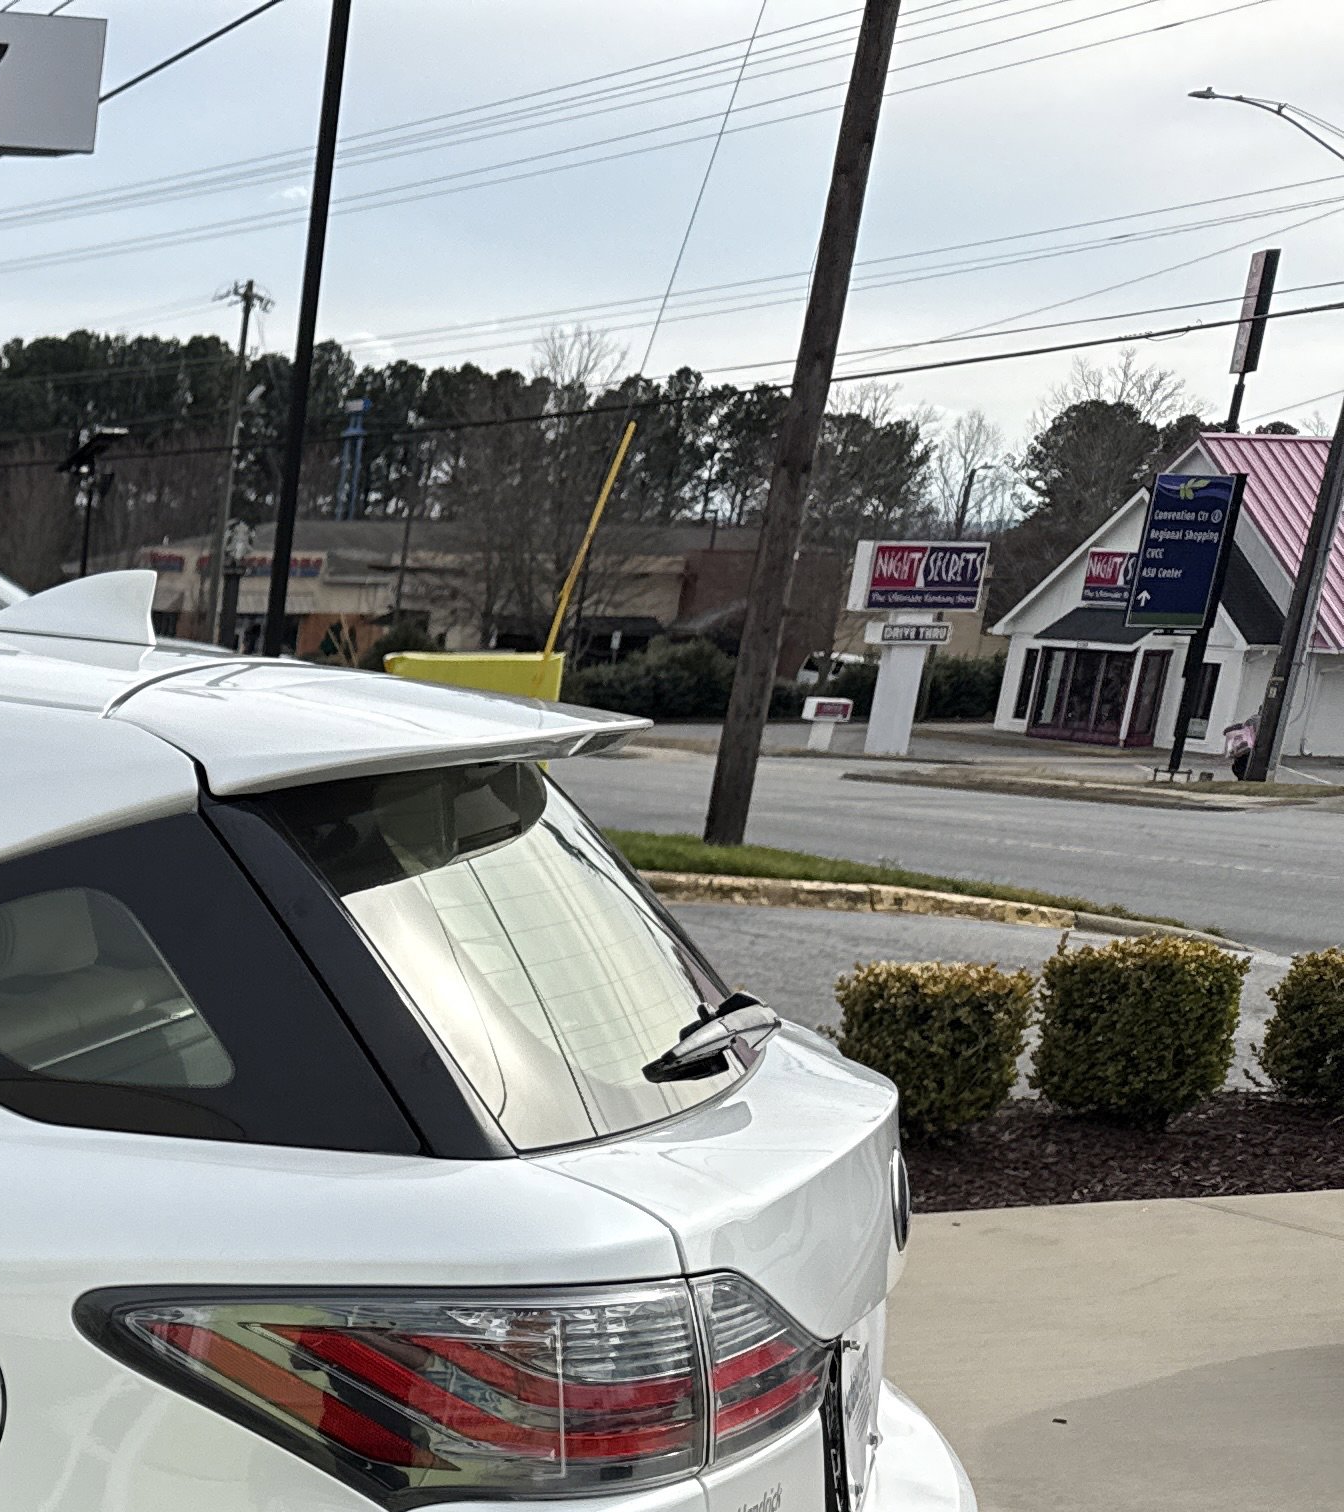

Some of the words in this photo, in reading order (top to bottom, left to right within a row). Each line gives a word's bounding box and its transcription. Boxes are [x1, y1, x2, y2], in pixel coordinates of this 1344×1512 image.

[1154, 509, 1195, 521] Convention
[1150, 528, 1183, 542] Regional
[1185, 529, 1219, 544] Shopping
[927, 551, 985, 582] SECRETS
[1158, 568, 1183, 579] Center
[884, 626, 917, 639] DRIVE
[919, 627, 947, 640] THRU
